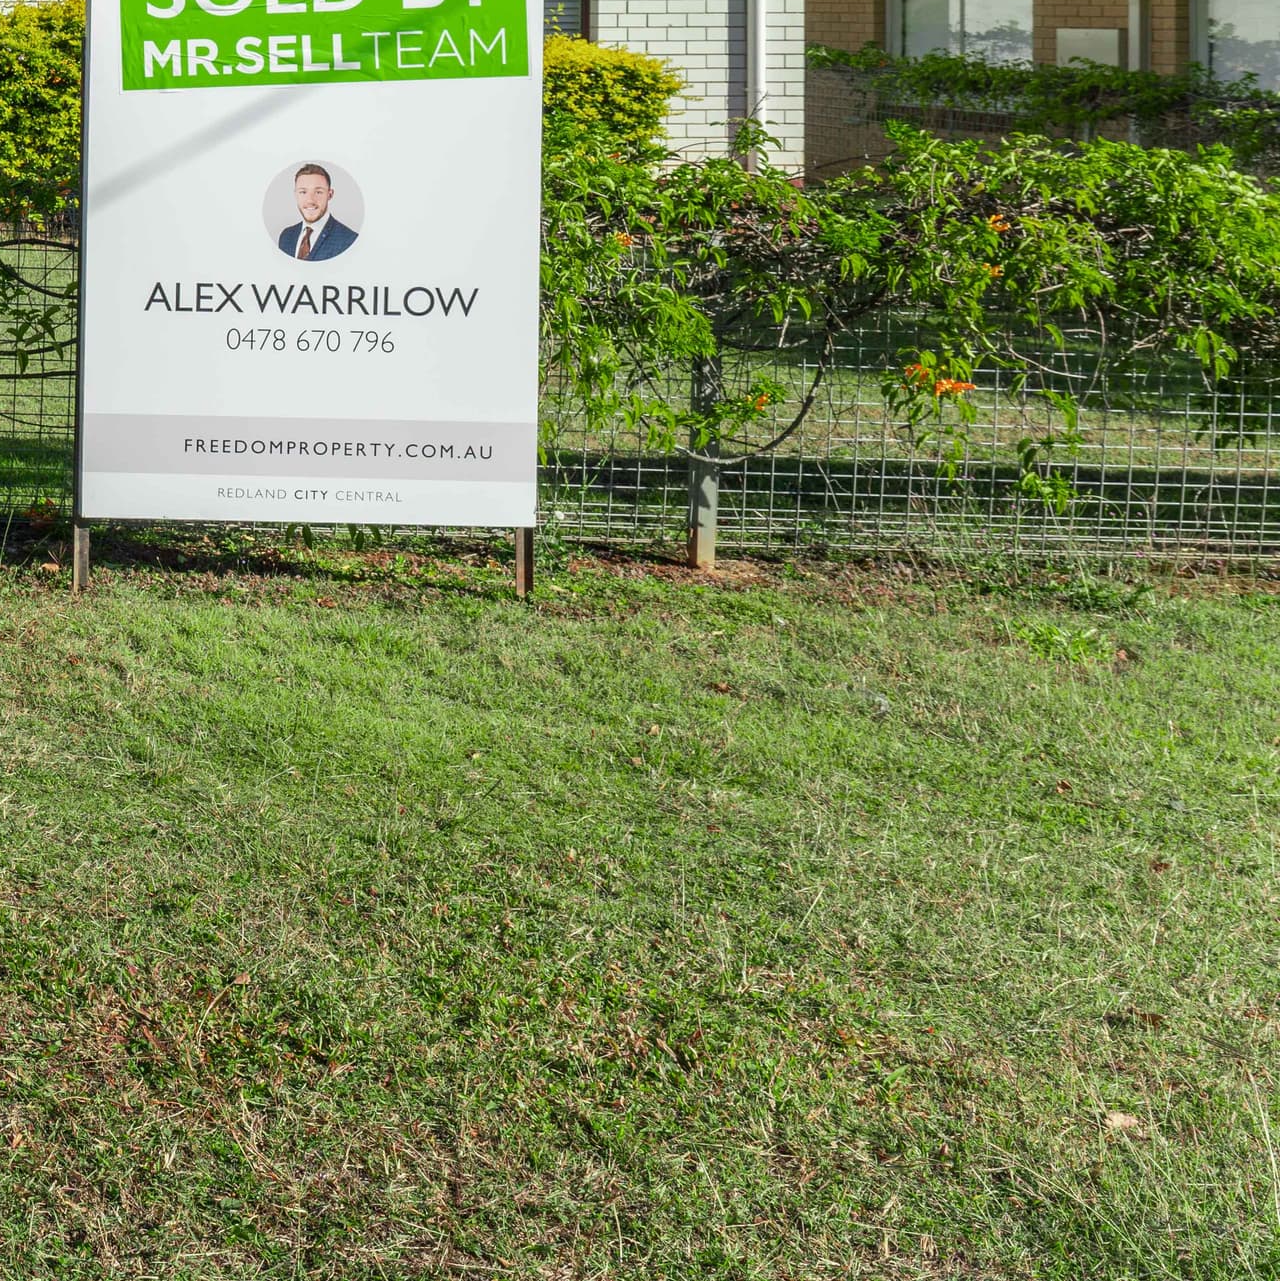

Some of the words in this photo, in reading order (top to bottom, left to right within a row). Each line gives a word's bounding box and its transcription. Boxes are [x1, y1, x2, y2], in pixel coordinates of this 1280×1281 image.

[144, 281, 244, 313] ALEX
[251, 284, 480, 317] WARRILOW
[226, 328, 286, 352] 0478
[296, 329, 341, 353] 670
[350, 330, 395, 354] 796
[184, 438, 493, 460] FREEDOMPROPERTY.COM.AU
[217, 487, 287, 500] REDLAND
[293, 489, 329, 501] CITY
[335, 490, 403, 503] CENTRAL
